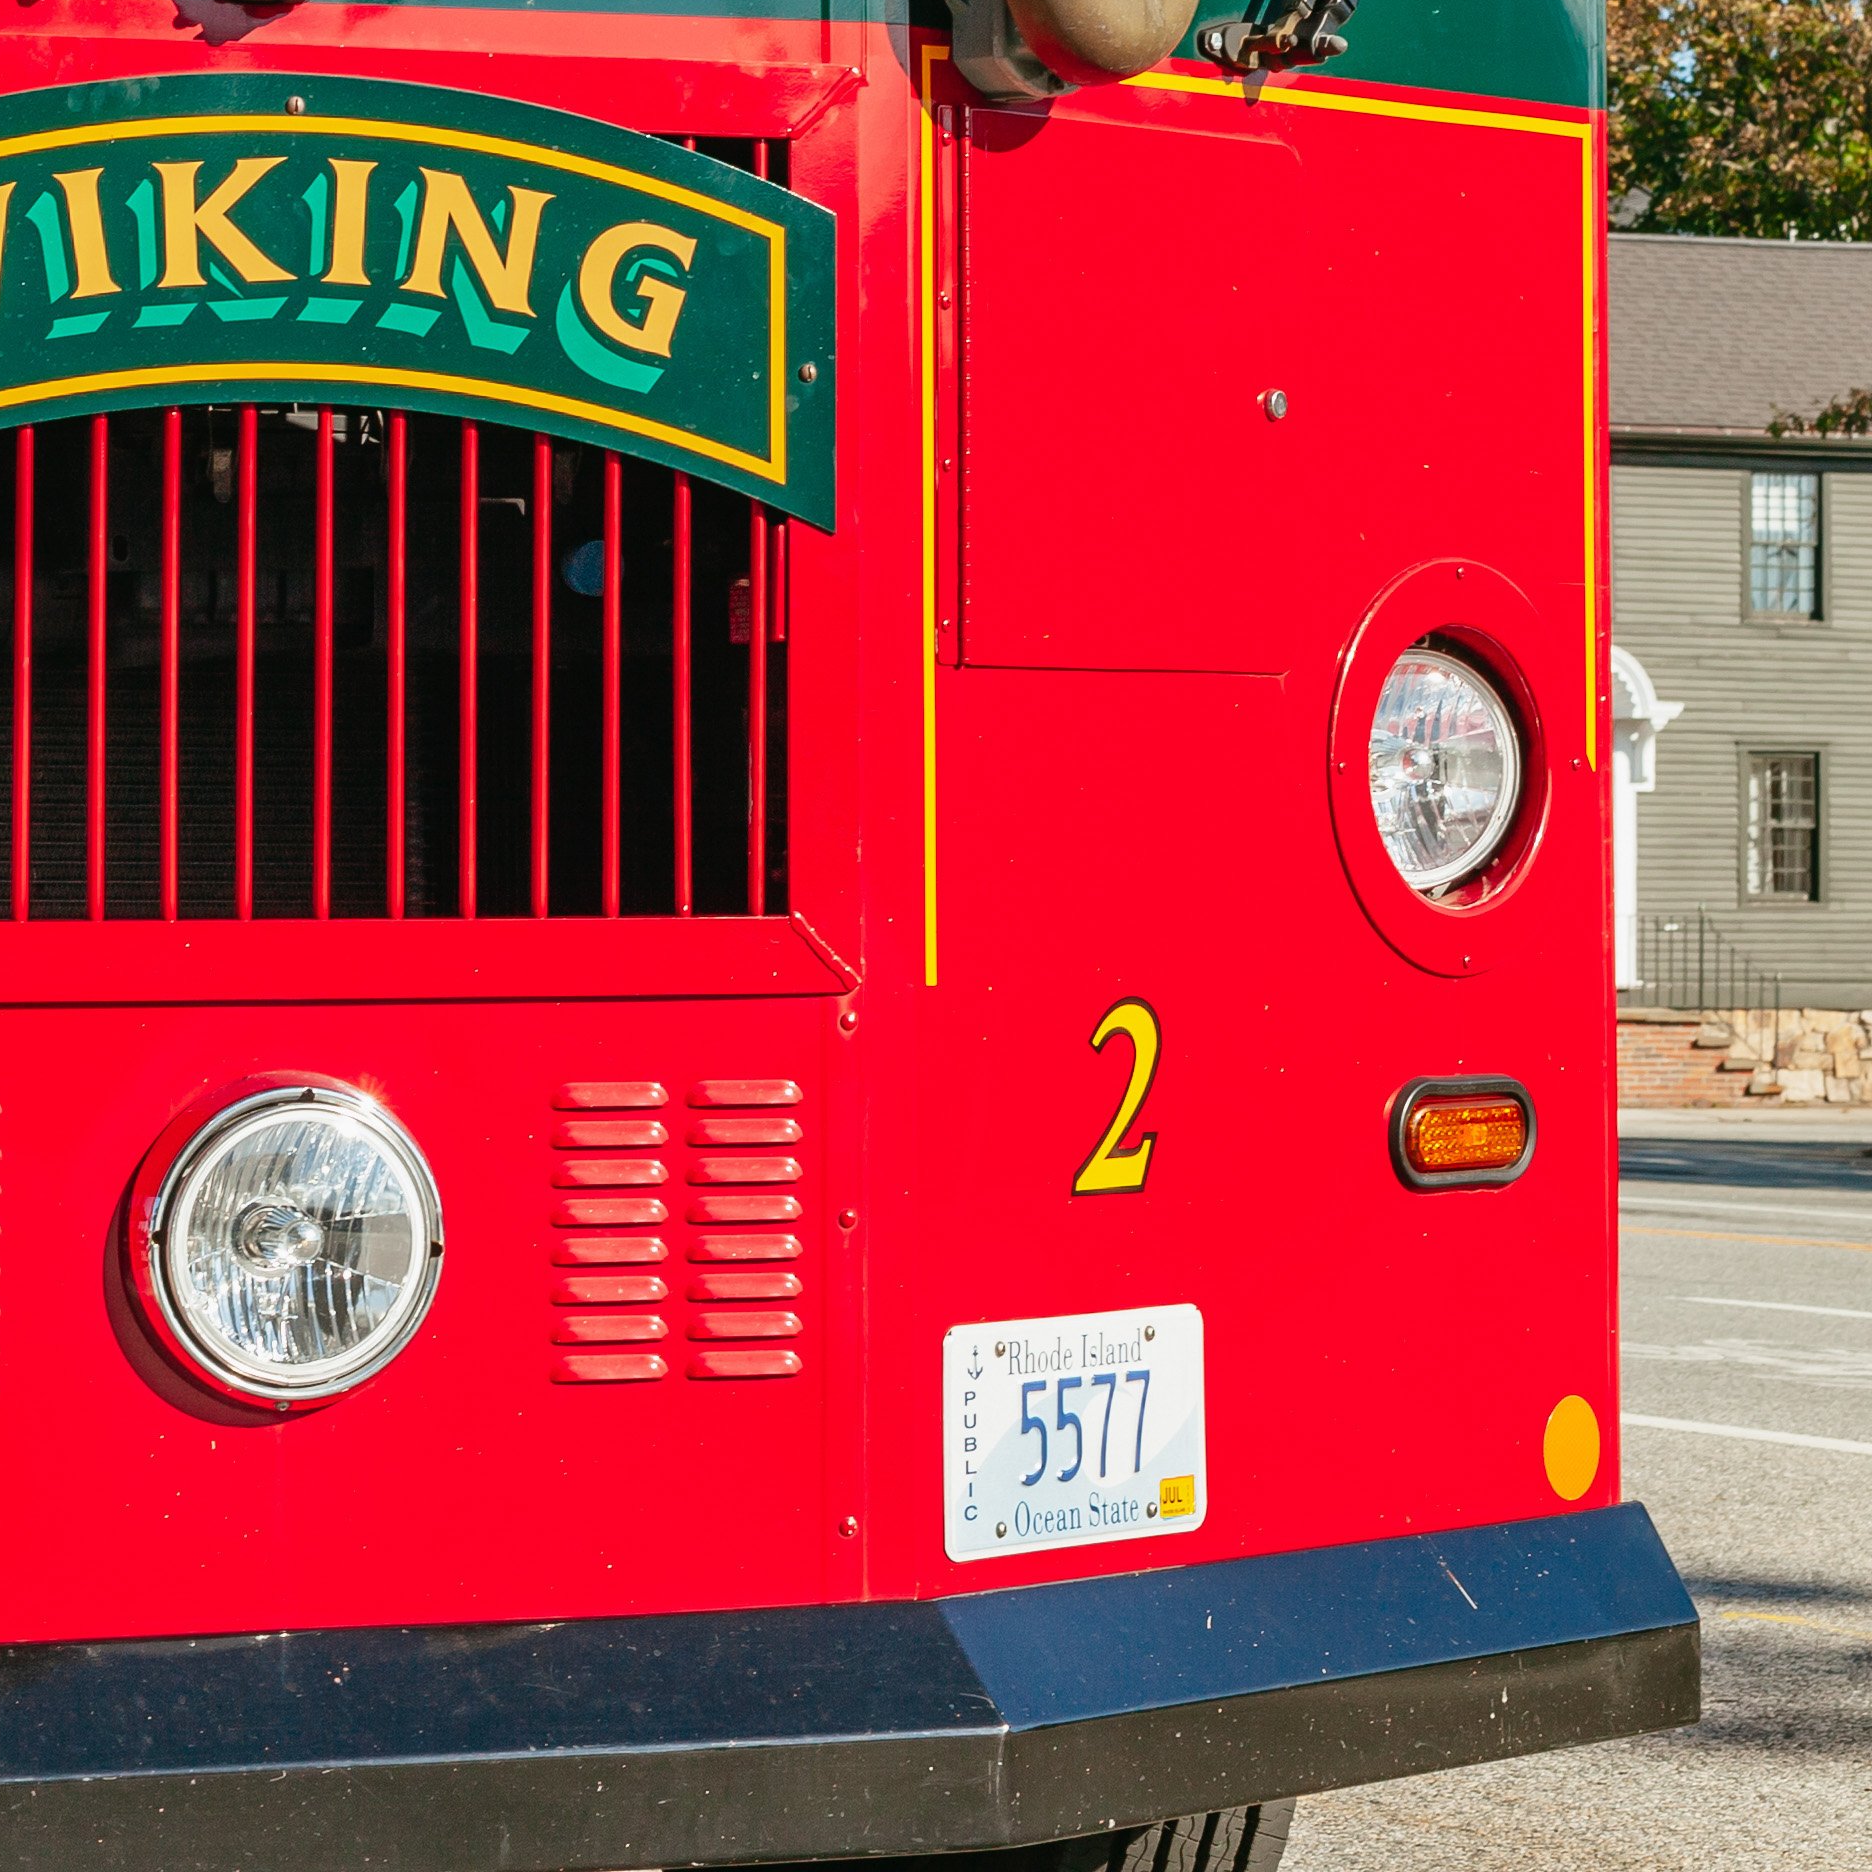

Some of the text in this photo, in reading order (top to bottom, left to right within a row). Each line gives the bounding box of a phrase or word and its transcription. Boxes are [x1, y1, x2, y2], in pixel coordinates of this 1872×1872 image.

[1071, 995, 1162, 1197] 2
[1007, 1328, 1143, 1376] Rhode Island
[963, 1390, 979, 1521] PUBLIC
[1021, 1369, 1151, 1487] 5577
[1014, 1490, 1140, 1537] Ocean State
[1162, 1485, 1184, 1504] JUL
